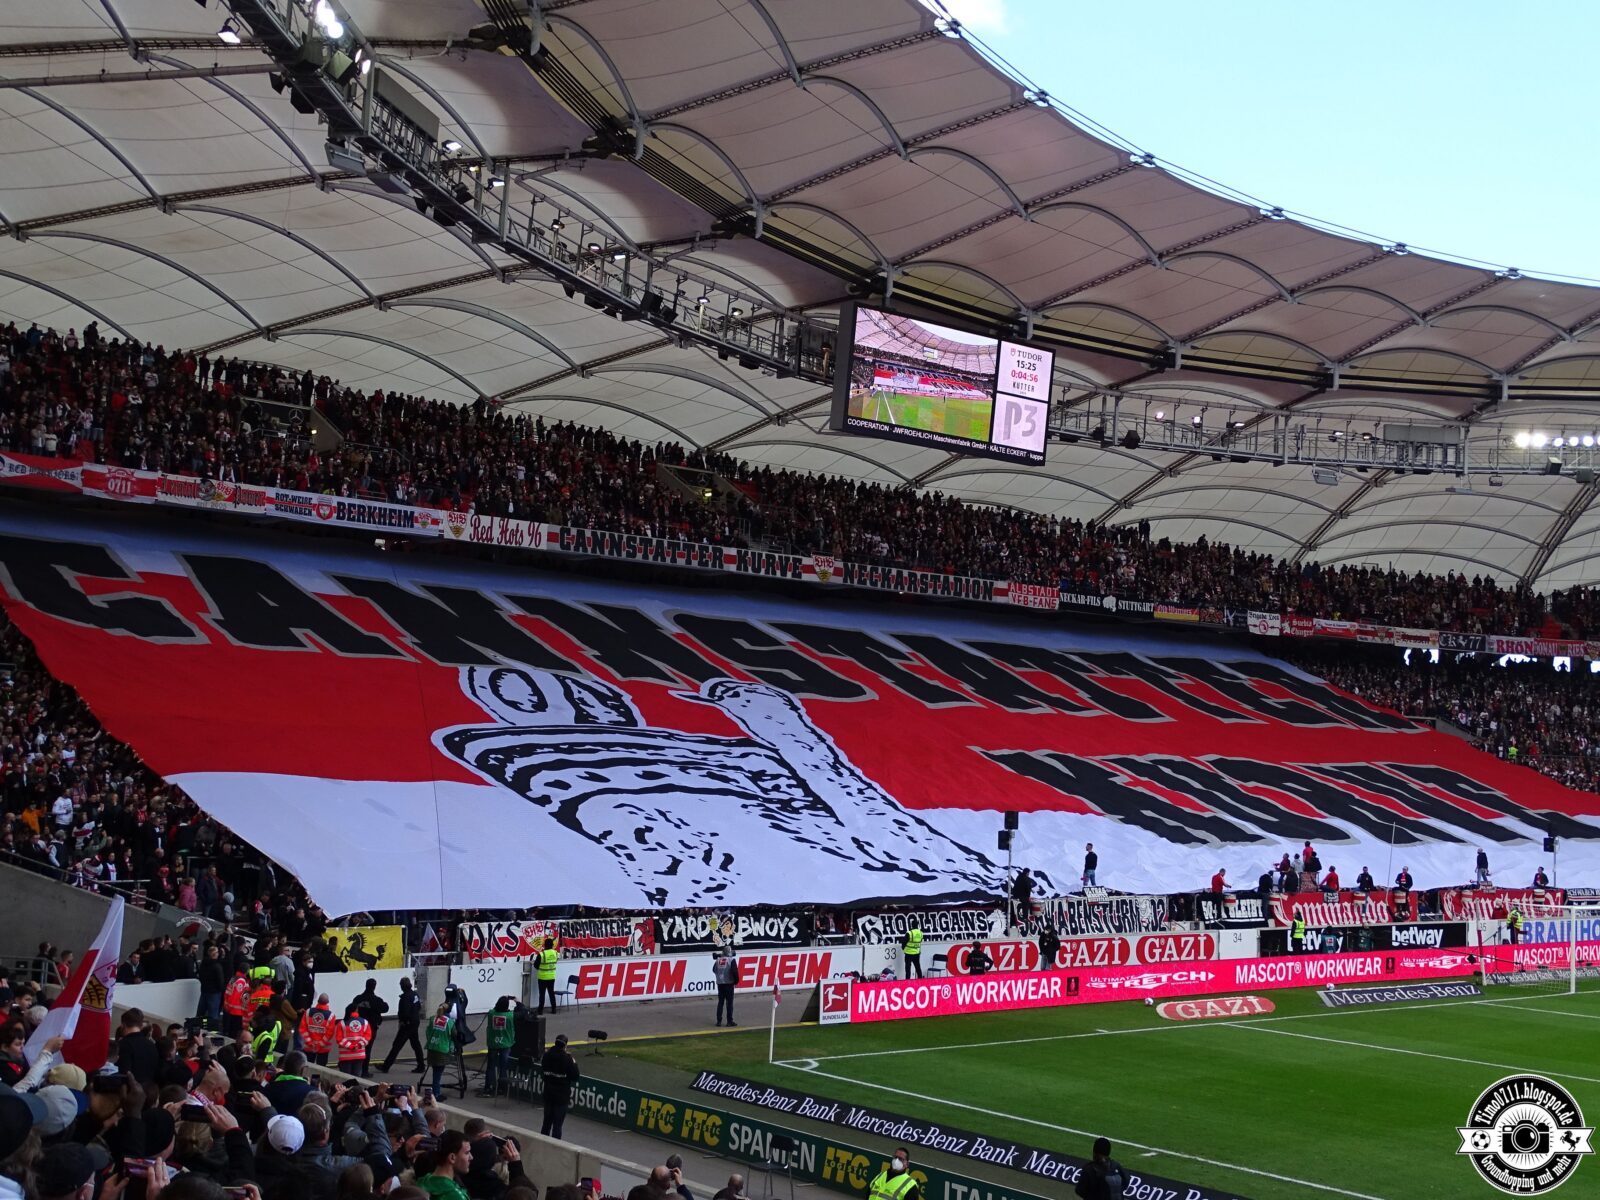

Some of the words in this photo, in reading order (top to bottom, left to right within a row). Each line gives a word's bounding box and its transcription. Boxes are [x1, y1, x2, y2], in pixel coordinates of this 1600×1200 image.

[1017, 350, 1042, 361] TUDOR
[1017, 360, 1037, 371] 15:25
[1011, 370, 1038, 382] 0:04:56
[847, 418, 889, 432] COOPERATION
[933, 434, 970, 447] Maschinenfabrik
[971, 441, 986, 450] GmbH
[1007, 447, 1027, 457] ECKERT
[108, 478, 131, 494] 0711
[274, 504, 313, 517] SCHWABEN
[336, 502, 415, 528] BERKHEIM
[470, 514, 494, 543] Red
[497, 518, 524, 546] Hots
[528, 522, 542, 548] 96
[559, 526, 724, 570] CANNSTATTER
[736, 549, 803, 579] KURVE
[843, 562, 994, 601] NECKARSTADION
[1009, 584, 1058, 597] ALBSTADT
[1059, 592, 1100, 607] NECKAR-FILS
[1118, 600, 1155, 612] STUTTGART
[660, 916, 708, 941] YARD
[737, 914, 799, 939] BWOYS
[879, 910, 988, 935] HOOLIGANS
[1232, 932, 1242, 944] 34
[1391, 926, 1443, 948] betway
[885, 948, 897, 960] 33
[478, 968, 494, 983] 32
[575, 960, 687, 999] EHEIM
[735, 952, 832, 989] EHEIM
[1088, 970, 1207, 989] STRETCH
[1305, 957, 1382, 980] WORKWEAR
[956, 977, 1062, 1006] WORKWEAR
[1330, 982, 1481, 1006] Mercedes-Benz
[822, 1013, 848, 1021] BUNDESLIGA
[637, 1097, 676, 1134] ITC
[681, 1108, 723, 1146] ITC
[693, 1071, 799, 1112] Mercedes-Benz
[797, 1097, 841, 1122] Bank
[842, 1107, 969, 1154] Mercedes-Benz
[968, 1137, 1019, 1166] Bank
[822, 1146, 870, 1190] ITC
